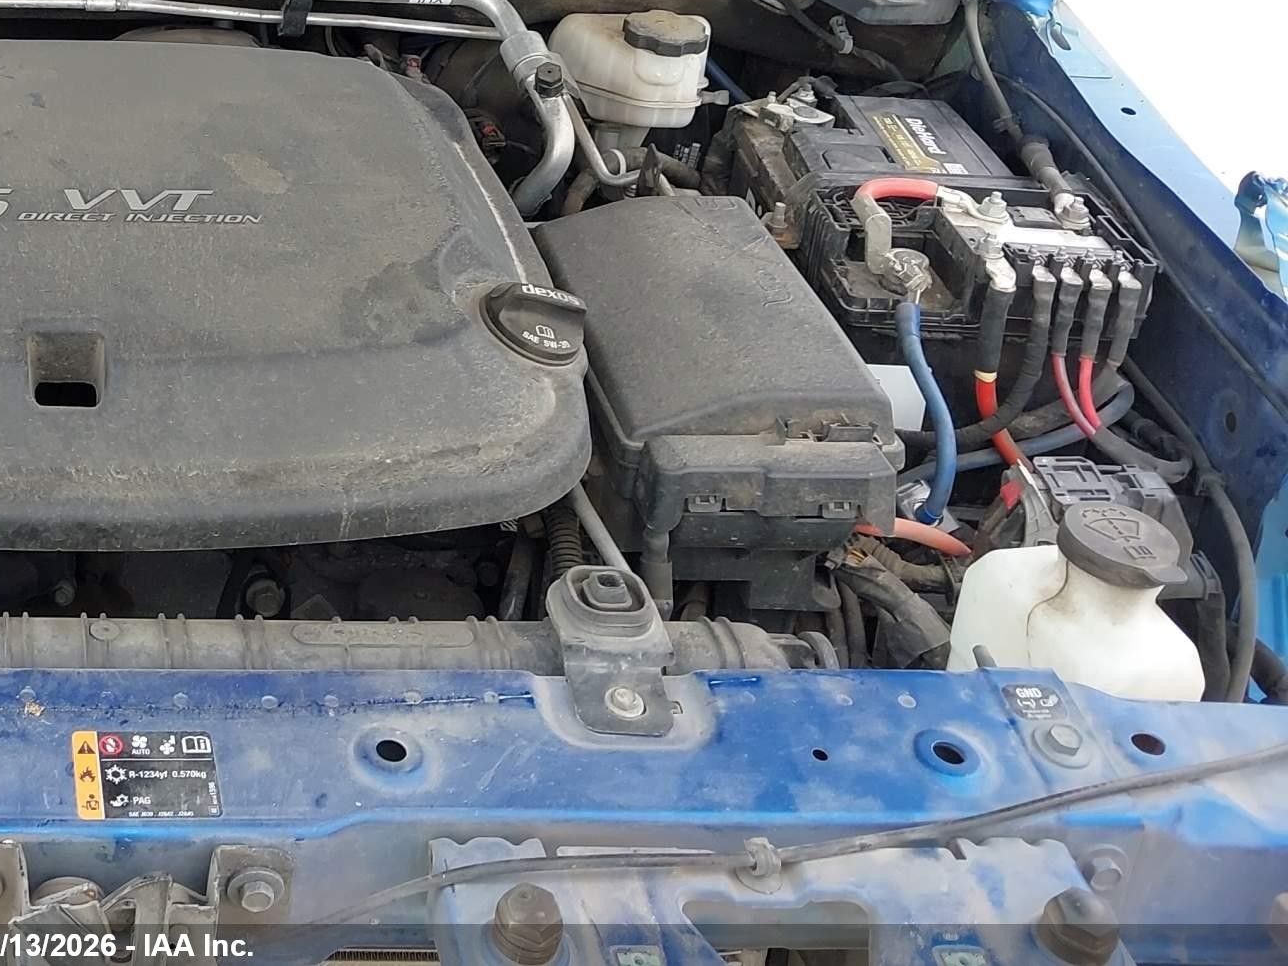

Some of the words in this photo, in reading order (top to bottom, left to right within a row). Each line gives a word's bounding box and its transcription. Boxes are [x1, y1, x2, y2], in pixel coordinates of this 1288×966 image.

[904, 117, 948, 155] DieHard
[62, 188, 214, 211] VVT
[16, 211, 116, 223] DIRECT
[125, 212, 264, 225] INJECTION
[522, 284, 580, 305] dexos
[522, 330, 540, 344] SAE
[1016, 688, 1041, 698] GND
[129, 771, 167, 779] R-1234yf
[132, 796, 152, 805] PAG
